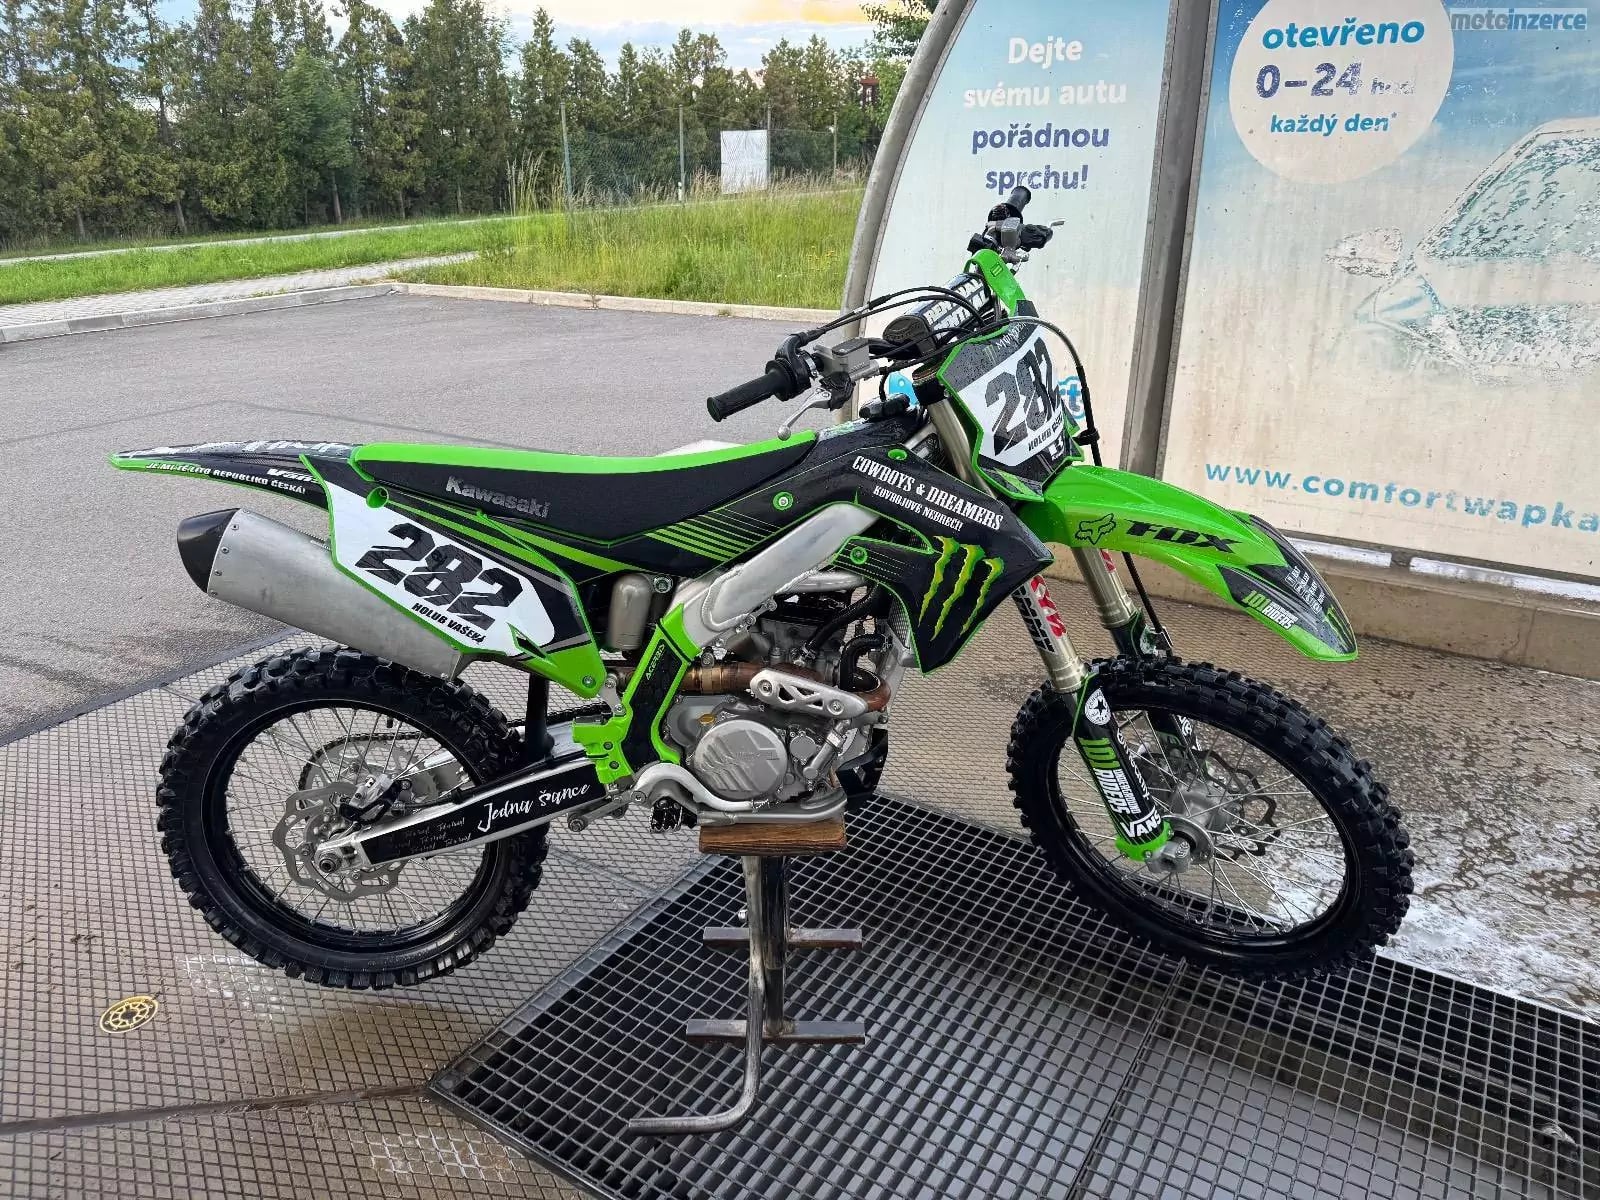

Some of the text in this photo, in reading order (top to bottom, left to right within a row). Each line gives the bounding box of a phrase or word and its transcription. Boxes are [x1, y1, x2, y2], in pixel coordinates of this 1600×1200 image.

[1262, 17, 1425, 49] otevřeno
[1008, 35, 1083, 69] Dejte
[963, 79, 1127, 108] svému autu
[972, 123, 1109, 154] pořádnou
[1270, 113, 1338, 136] každý
[985, 164, 1088, 195] sprchu!
[985, 337, 1060, 456] 282
[445, 475, 550, 519] Kawasaki
[852, 455, 1004, 531] COWBOYS & DREAMERS
[1125, 519, 1242, 553] FOX
[355, 522, 523, 631] 282
[411, 602, 447, 625] HOLUB
[477, 782, 591, 833] Jedna Šance
[1093, 767, 1131, 815] RIDERS
[1120, 805, 1162, 838] VANS
